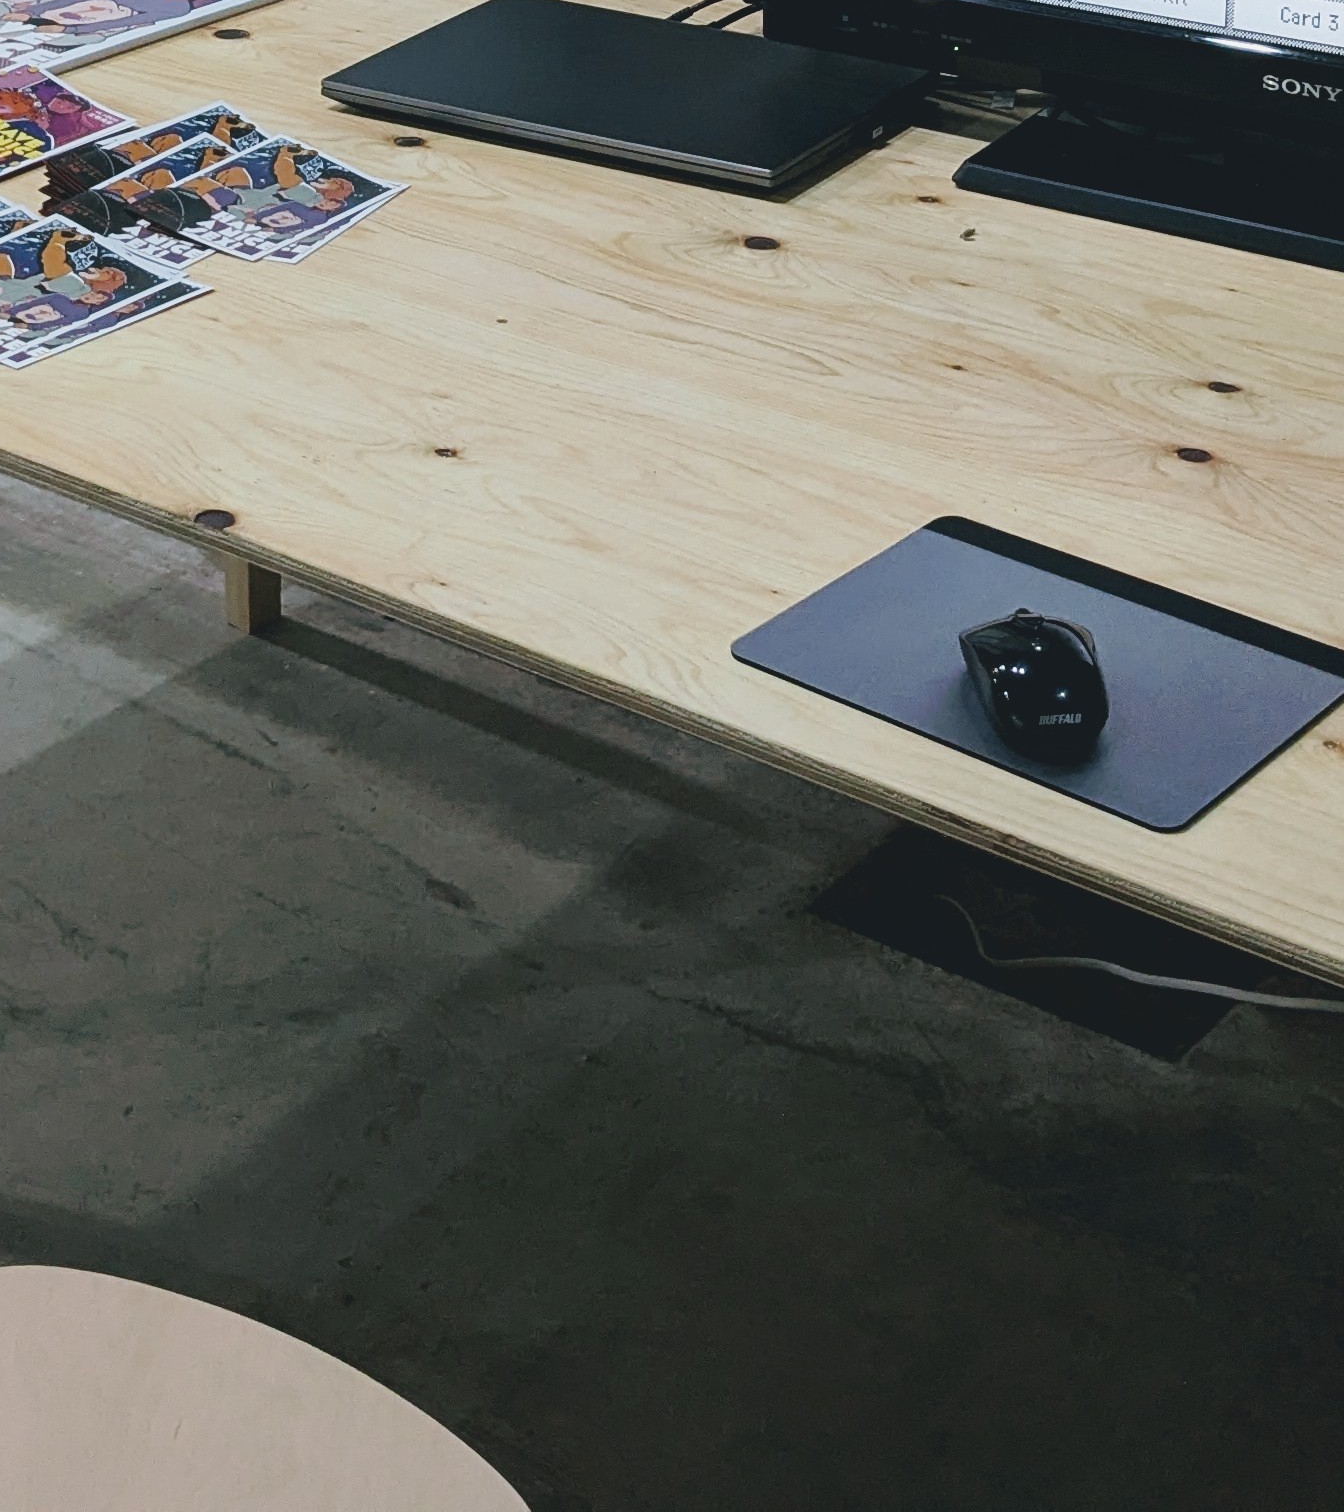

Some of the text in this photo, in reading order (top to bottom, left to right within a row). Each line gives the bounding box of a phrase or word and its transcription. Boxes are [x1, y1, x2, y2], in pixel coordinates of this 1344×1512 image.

[1280, 6, 1339, 32] Card 3
[1262, 74, 1343, 103] SONY
[1039, 713, 1082, 726] BUFFALO
